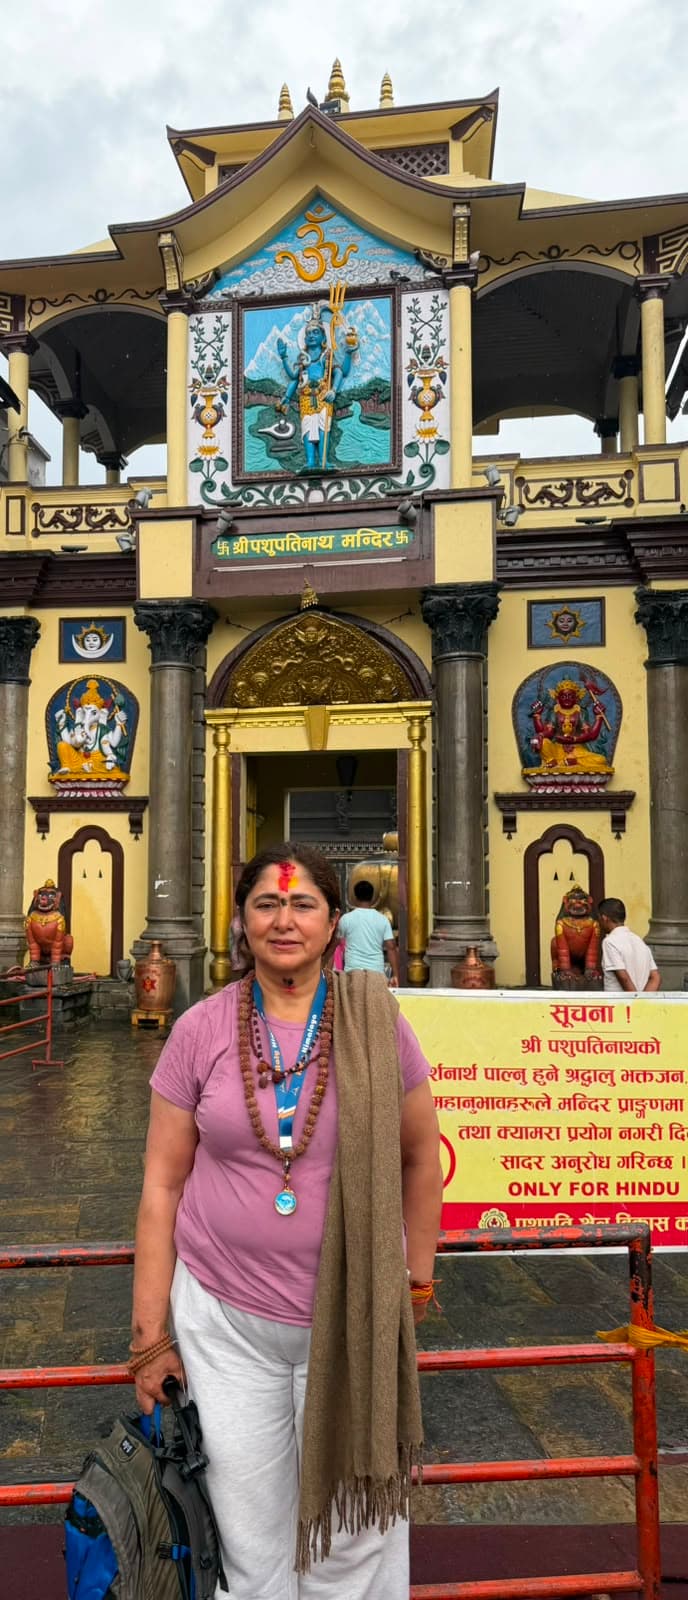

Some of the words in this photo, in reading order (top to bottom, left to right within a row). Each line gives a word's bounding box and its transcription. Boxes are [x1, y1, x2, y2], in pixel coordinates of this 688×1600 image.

[232, 535, 248, 555] श्री
[250, 532, 335, 557] पशुपतिनाथ
[341, 528, 393, 549] मन्दिर
[549, 1004, 615, 1028] सूचना
[521, 1034, 542, 1054] श्री
[548, 1035, 661, 1058] पशुपतिनाथको
[429, 1063, 477, 1082] र्शनार्थ
[484, 1067, 527, 1086] पाल्नु
[532, 1064, 560, 1086] हुने
[557, 1092, 612, 1112] मन्दिर
[458, 1126, 491, 1140] तथा
[497, 1126, 561, 1141] क्यामरा
[567, 1122, 613, 1142] प्रयोग
[618, 1122, 664, 1141] नगरी
[669, 1121, 688, 1141] दि
[500, 1155, 545, 1170] सादर
[551, 1151, 611, 1173] अनुरोध
[617, 1151, 674, 1170] गरिन्छ
[508, 1182, 562, 1196] ONLY
[569, 1181, 609, 1196] FOR
[615, 1181, 681, 1196] HINDU
